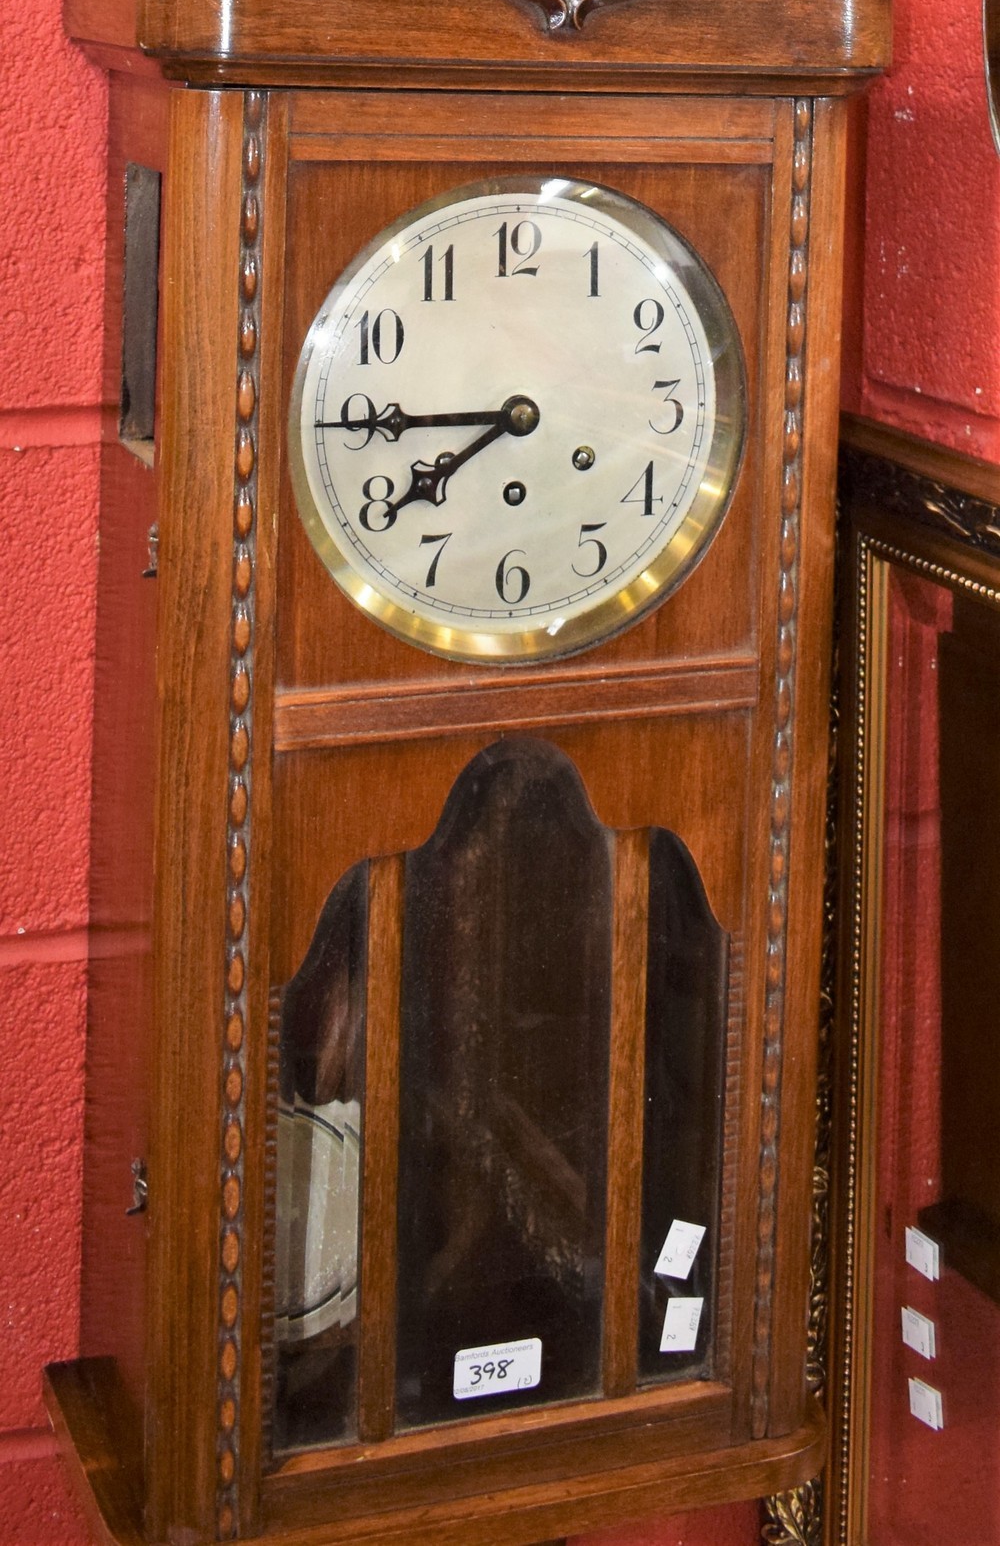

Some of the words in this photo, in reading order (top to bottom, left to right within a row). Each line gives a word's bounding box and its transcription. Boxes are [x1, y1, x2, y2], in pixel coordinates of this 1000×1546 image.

[418, 244, 457, 302] 11
[492, 220, 542, 278] 12
[583, 241, 602, 298] 1
[354, 308, 405, 365] 10
[633, 298, 665, 354] 2
[341, 393, 377, 450] 9
[648, 379, 684, 434] 3
[358, 475, 398, 532] 8
[620, 460, 664, 516] 4
[419, 532, 453, 588] 7
[495, 549, 530, 604] 6
[571, 522, 607, 577] 5
[469, 1359, 514, 1385] 398
